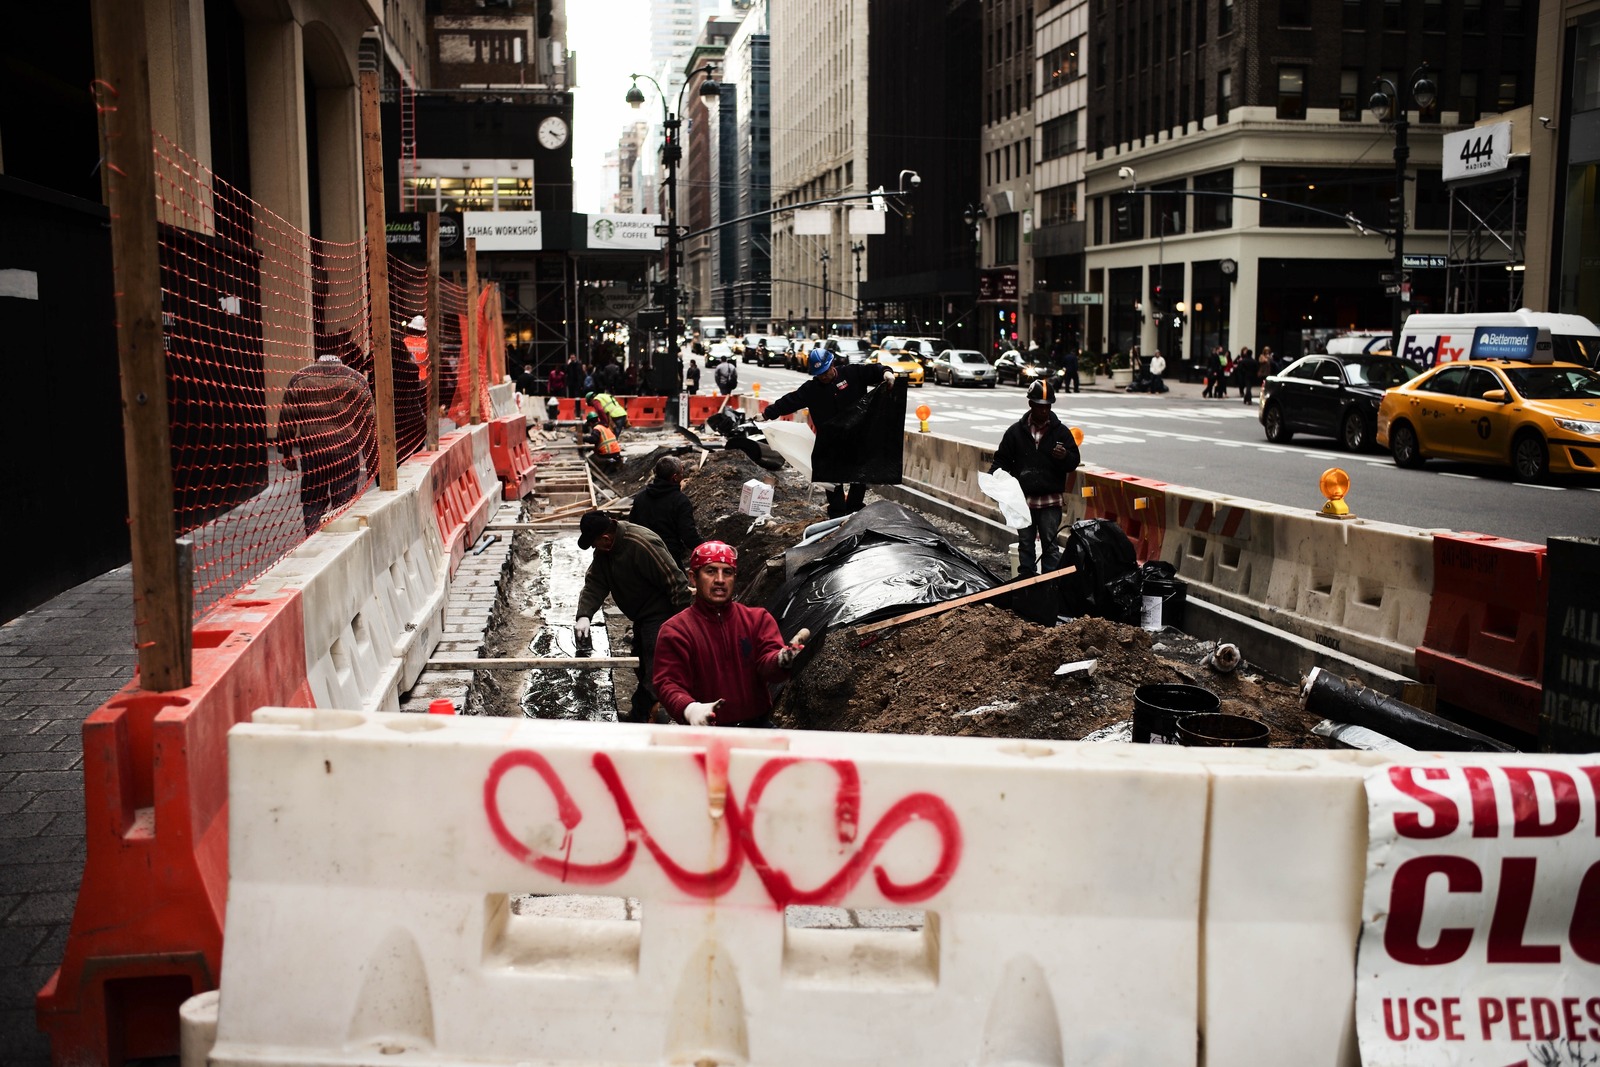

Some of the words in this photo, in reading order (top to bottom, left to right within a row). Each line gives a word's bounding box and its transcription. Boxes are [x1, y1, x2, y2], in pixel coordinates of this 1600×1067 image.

[1460, 134, 1493, 164] 444
[1465, 161, 1491, 170] MADISON
[467, 226, 493, 236] SAHAG
[494, 226, 538, 236] WORKSHOP
[616, 221, 655, 229] STARBUCKS
[1489, 333, 1529, 346] Betterment
[1402, 336, 1465, 370] FedEx
[1561, 653, 1600, 690] INT
[1382, 997, 1465, 1041] USE
